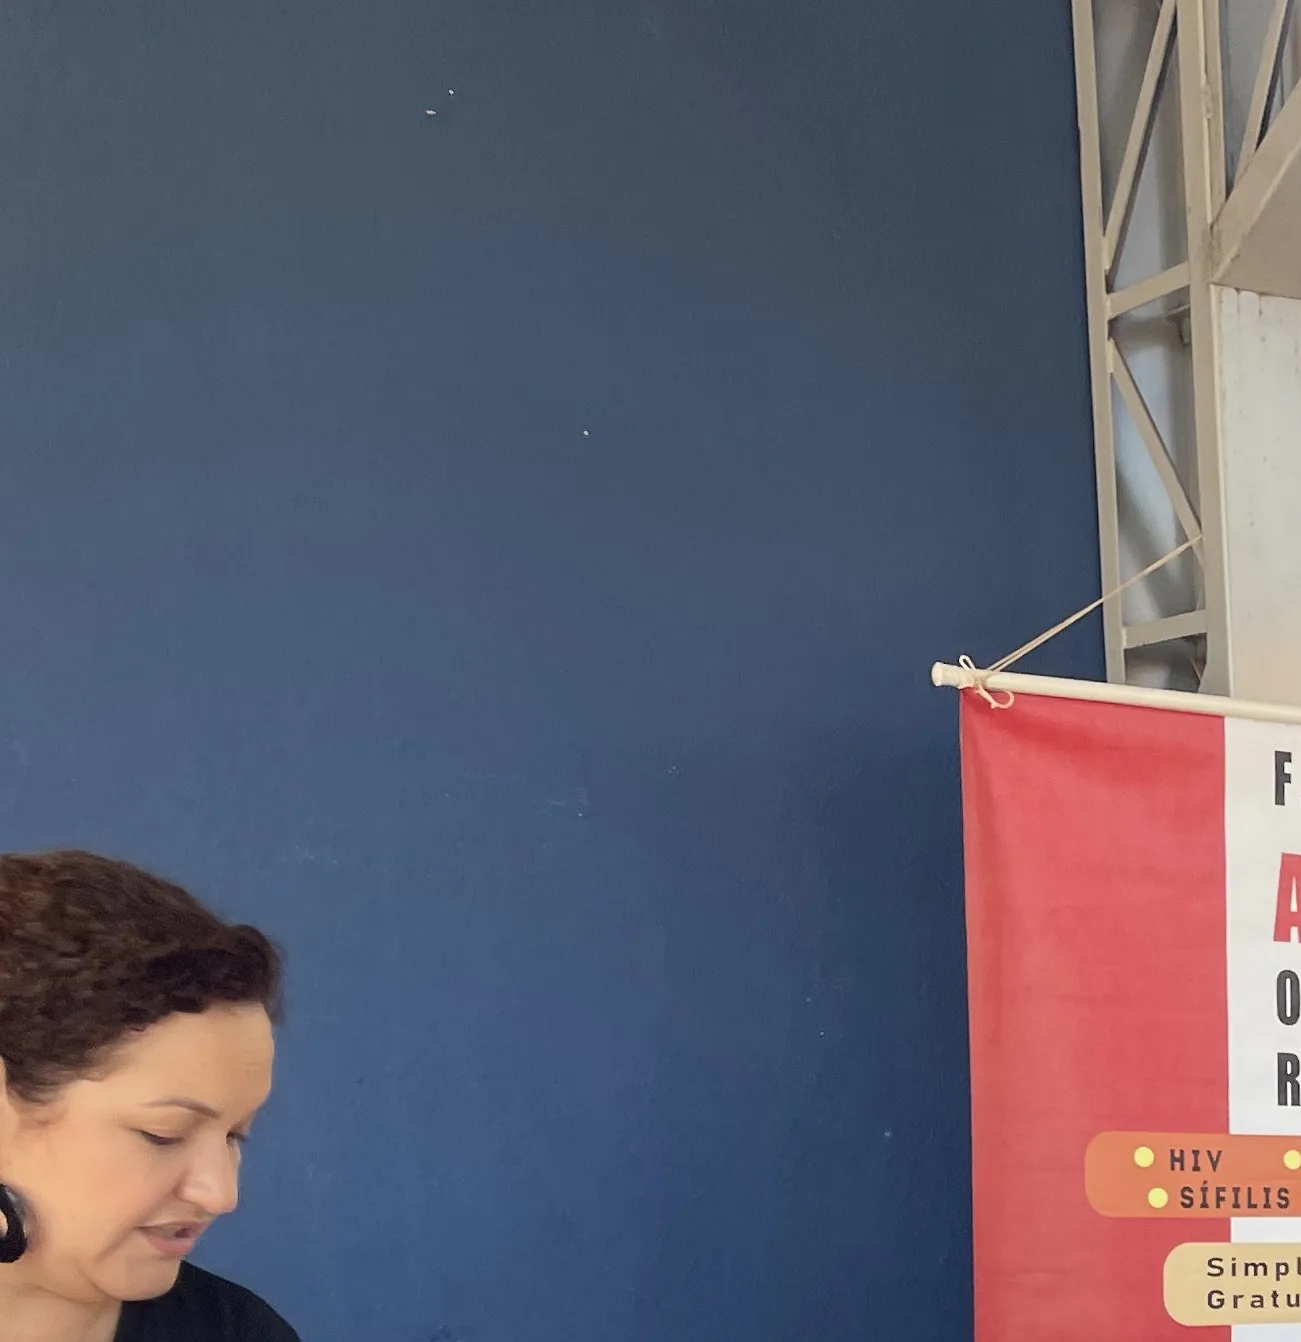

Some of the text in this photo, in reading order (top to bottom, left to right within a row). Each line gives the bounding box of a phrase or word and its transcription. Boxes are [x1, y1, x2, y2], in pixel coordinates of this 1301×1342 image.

[1276, 969, 1300, 1026] O
[1170, 1149, 1222, 1172] HIV
[1180, 1180, 1290, 1209] SÍFILIS
